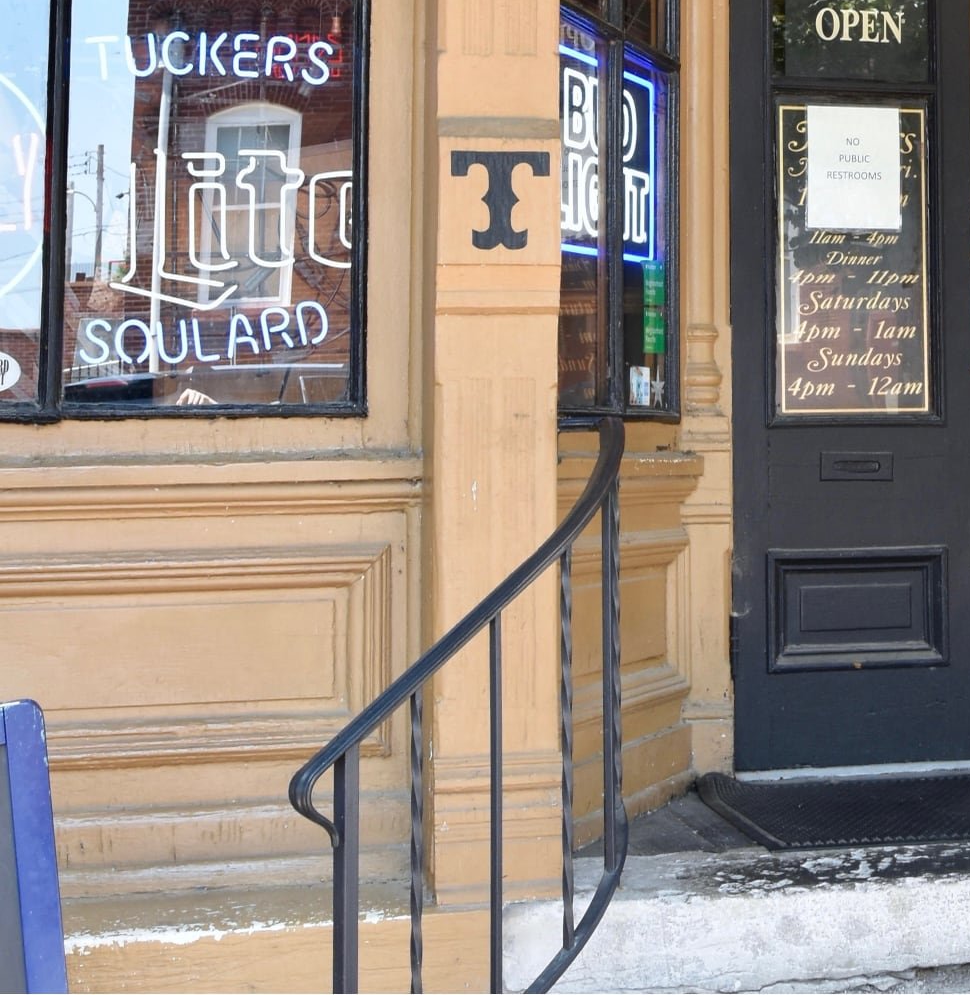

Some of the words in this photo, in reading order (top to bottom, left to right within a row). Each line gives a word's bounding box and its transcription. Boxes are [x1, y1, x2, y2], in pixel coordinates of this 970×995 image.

[815, 7, 904, 44] OPEN
[85, 30, 334, 86] TUCKERS
[845, 137, 860, 146] NO
[839, 154, 871, 163] PUBLIC
[826, 171, 882, 181] RESTROOMS
[450, 150, 550, 250] T
[809, 230, 846, 245] 11am
[866, 230, 899, 247] 4pm
[826, 251, 884, 266] Dinner
[788, 269, 836, 286] 4pm
[866, 269, 920, 286] 11pm
[799, 290, 912, 315] Saturdays
[79, 301, 329, 365] SOULARD
[793, 320, 841, 342] 4pm
[874, 320, 917, 339] 1am
[807, 347, 903, 372] Sundays
[787, 377, 836, 400] 4pm
[868, 376, 924, 397] 12am
